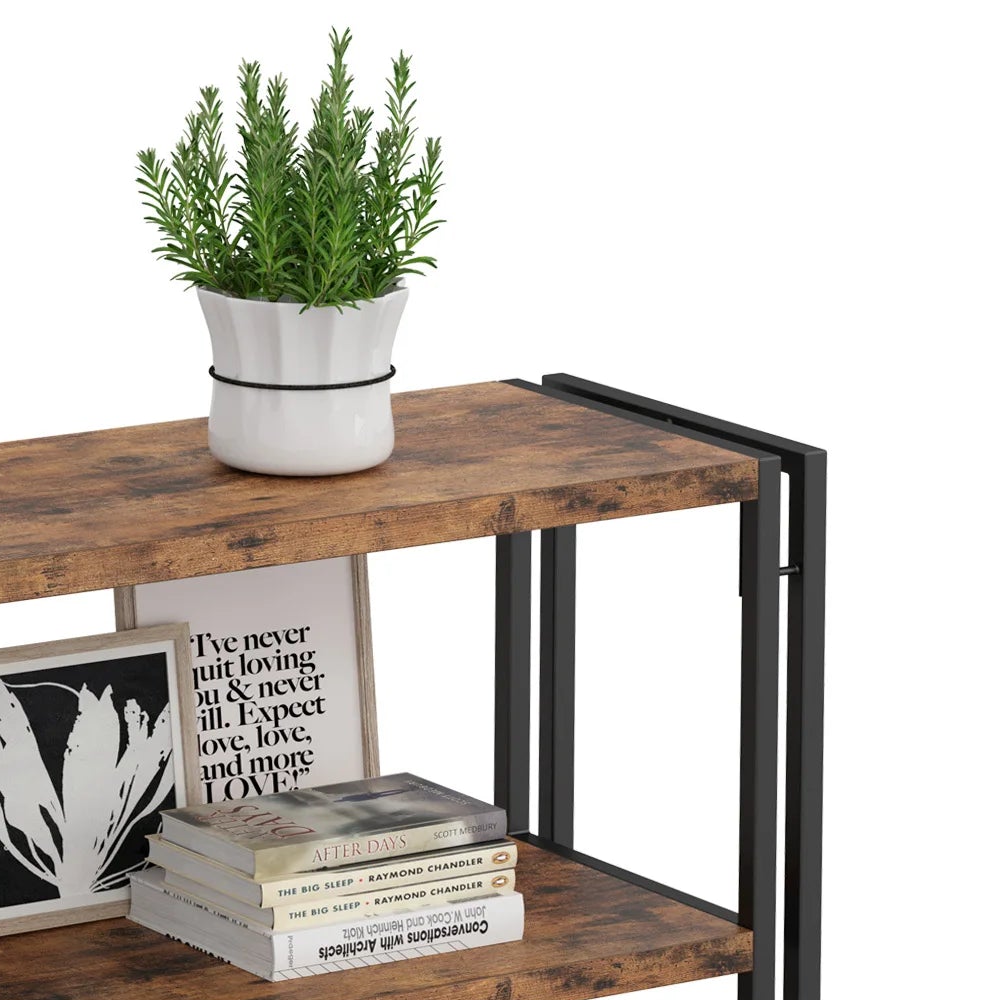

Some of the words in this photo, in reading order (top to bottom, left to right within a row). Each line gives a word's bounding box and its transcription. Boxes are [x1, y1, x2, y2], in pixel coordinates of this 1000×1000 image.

[243, 626, 311, 651] never
[239, 649, 316, 676] loving
[195, 688, 220, 708] ou
[226, 678, 254, 703] &
[258, 673, 325, 699] never
[197, 706, 231, 732] ill.
[237, 696, 326, 728] Expect
[256, 725, 312, 748] love,
[200, 753, 245, 781] and
[249, 749, 315, 774] more
[312, 841, 362, 864] AFTER
[367, 834, 408, 854] DAYS
[433, 830, 458, 840] SCOTT
[459, 822, 498, 836] MEDBURY
[277, 887, 298, 897] THE
[301, 883, 320, 894] BIG
[324, 878, 355, 890] SLEEP
[368, 867, 424, 883] RAYMOND
[427, 857, 483, 873] CHANDLER
[288, 910, 307, 920] THE
[311, 906, 329, 917] BIG
[333, 901, 361, 913] SLEEP
[374, 890, 427, 906] RAYMOND
[430, 880, 483, 896] CHANDLER
[405, 914, 425, 931] and
[467, 905, 487, 921] John
[342, 925, 366, 940] Klotz
[366, 919, 404, 936] Heinrich
[407, 919, 489, 943] Conversations
[318, 939, 377, 961] Architects
[380, 935, 404, 951] with
